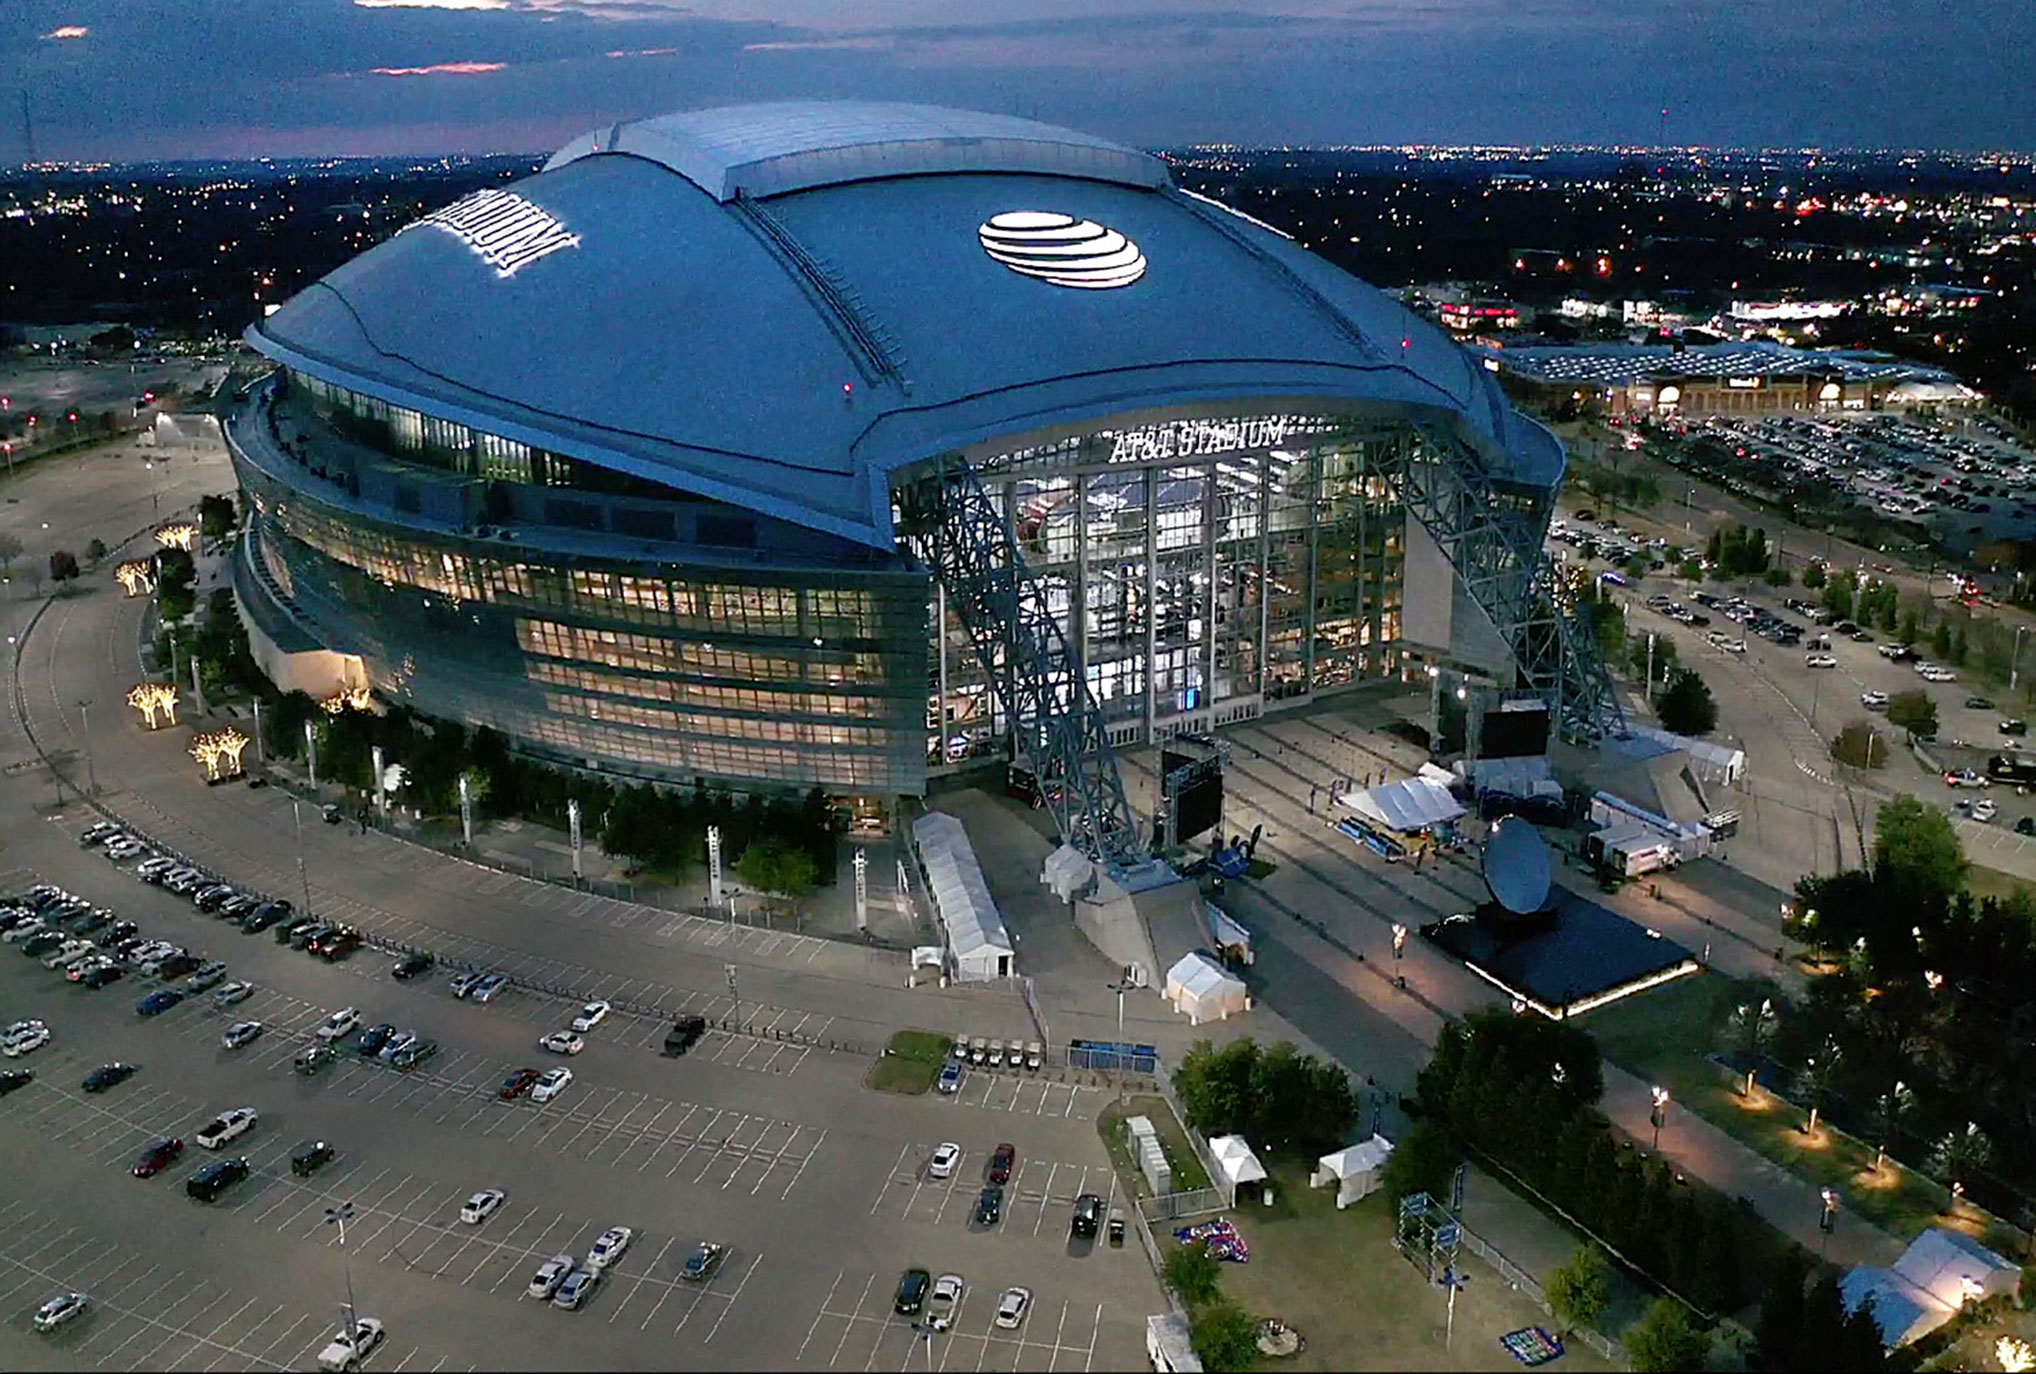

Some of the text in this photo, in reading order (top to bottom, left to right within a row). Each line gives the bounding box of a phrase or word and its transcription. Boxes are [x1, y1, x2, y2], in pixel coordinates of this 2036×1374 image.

[424, 188, 581, 277] ADIUM
[1108, 420, 1285, 464] AT&T STADIUM
